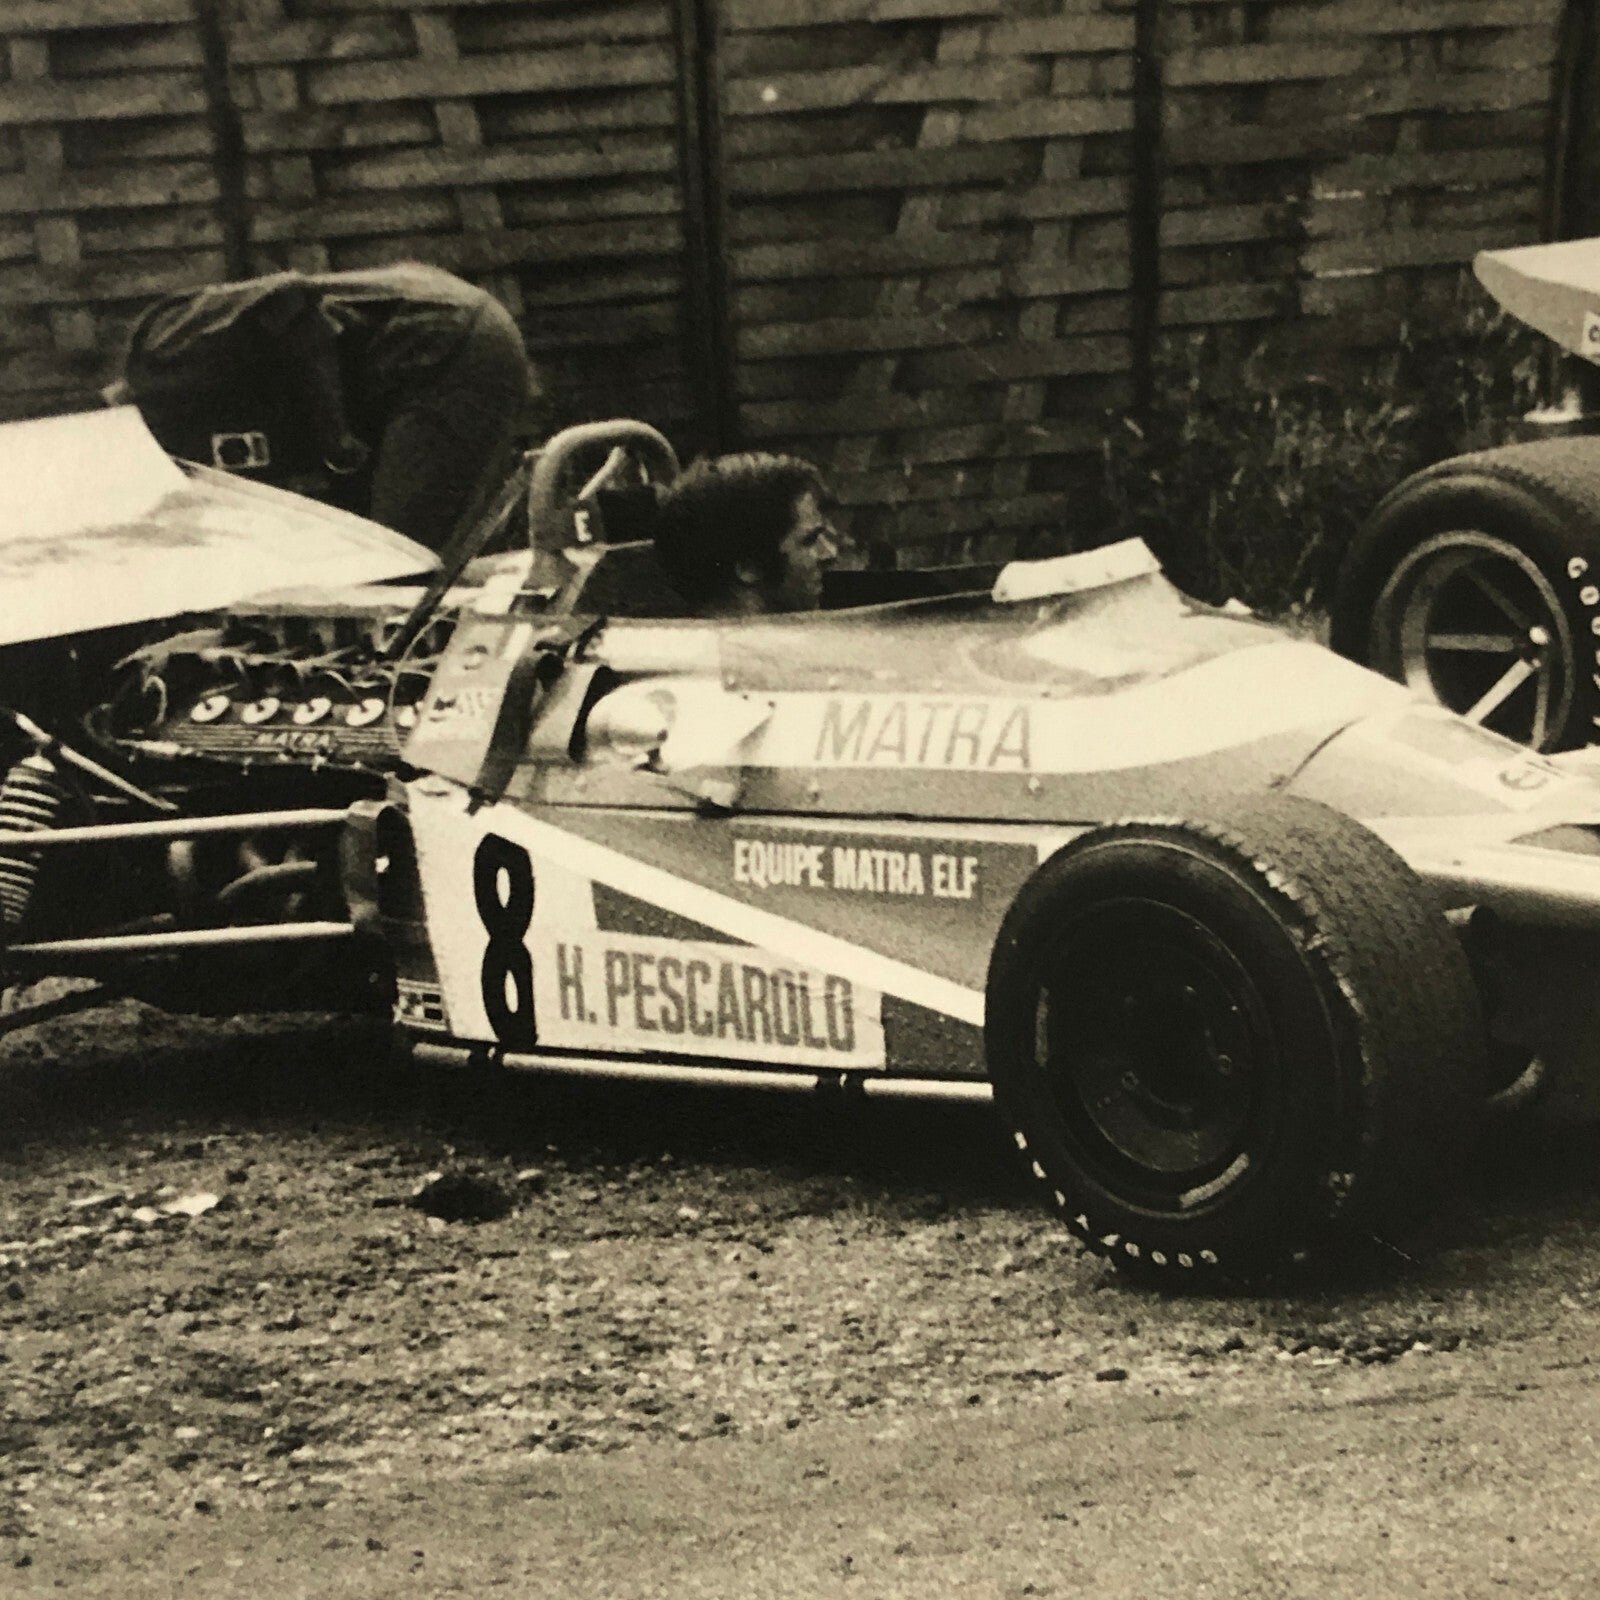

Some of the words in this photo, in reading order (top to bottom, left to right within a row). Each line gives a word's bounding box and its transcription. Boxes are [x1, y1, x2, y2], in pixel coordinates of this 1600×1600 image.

[814, 700, 1030, 768] MATRA
[734, 839, 826, 889] EQUIPE
[833, 846, 925, 895] MATRA
[932, 854, 979, 899] ELF
[473, 832, 538, 1048] 8
[556, 943, 598, 1022] H.
[605, 949, 857, 1052] PESCAROLO
